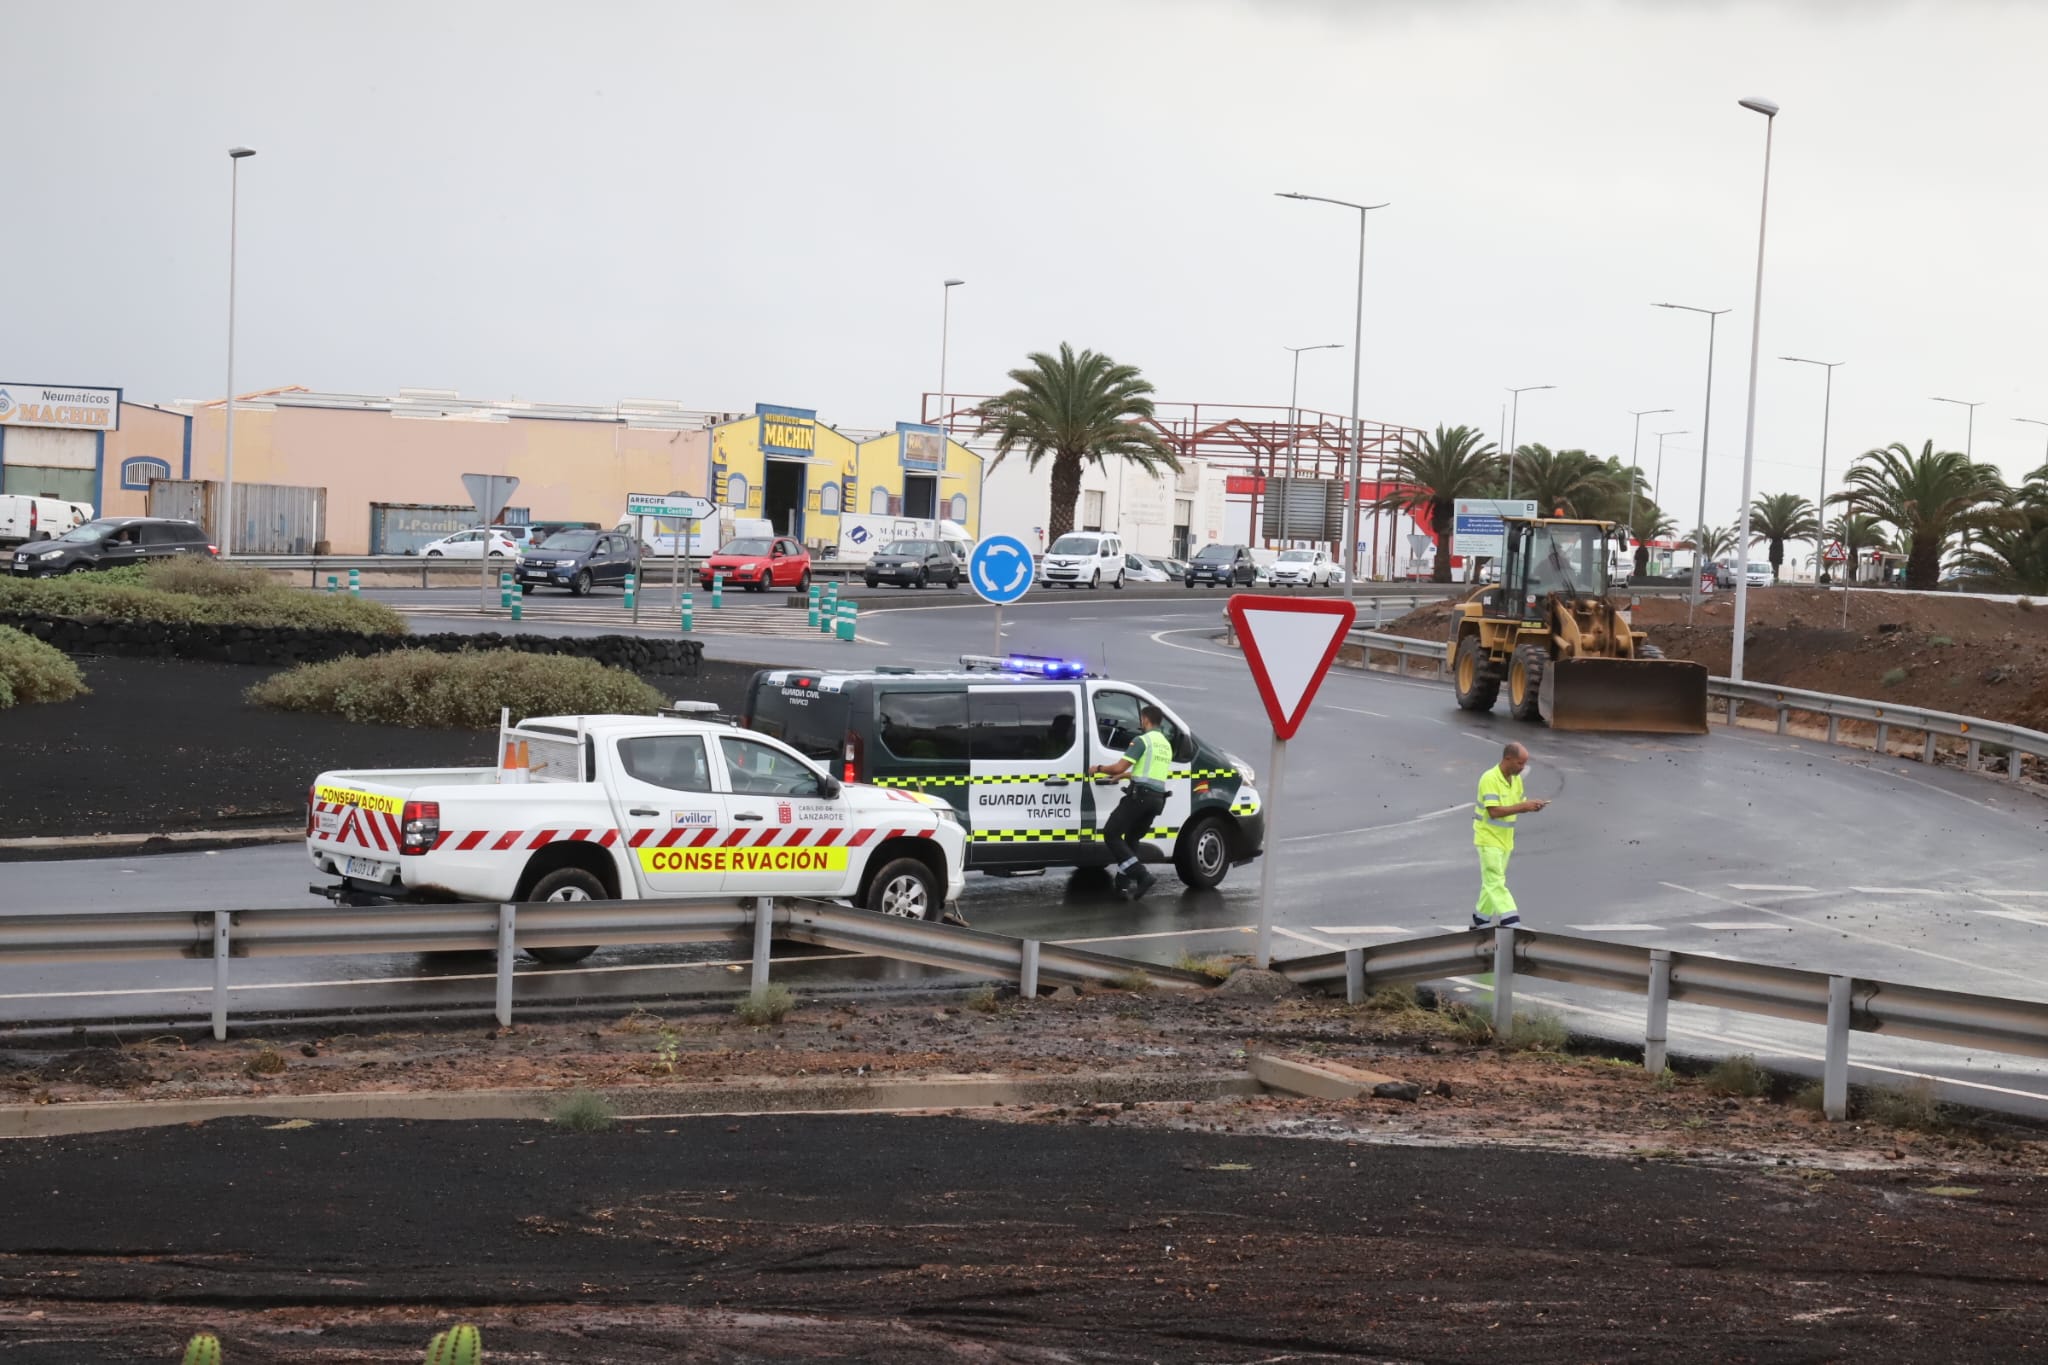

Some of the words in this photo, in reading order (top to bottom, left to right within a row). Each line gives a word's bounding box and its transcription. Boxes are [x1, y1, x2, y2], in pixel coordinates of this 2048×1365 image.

[764, 423, 814, 450] MACHIN
[630, 496, 665, 505] ARRECIFE
[781, 687, 805, 698] GUARDIA
[806, 690, 820, 699] CIVIL
[979, 794, 1037, 806] GUARDIA
[1041, 793, 1072, 805] CIVIL
[684, 812, 712, 824] villar
[799, 813, 844, 821] LANZAROTE
